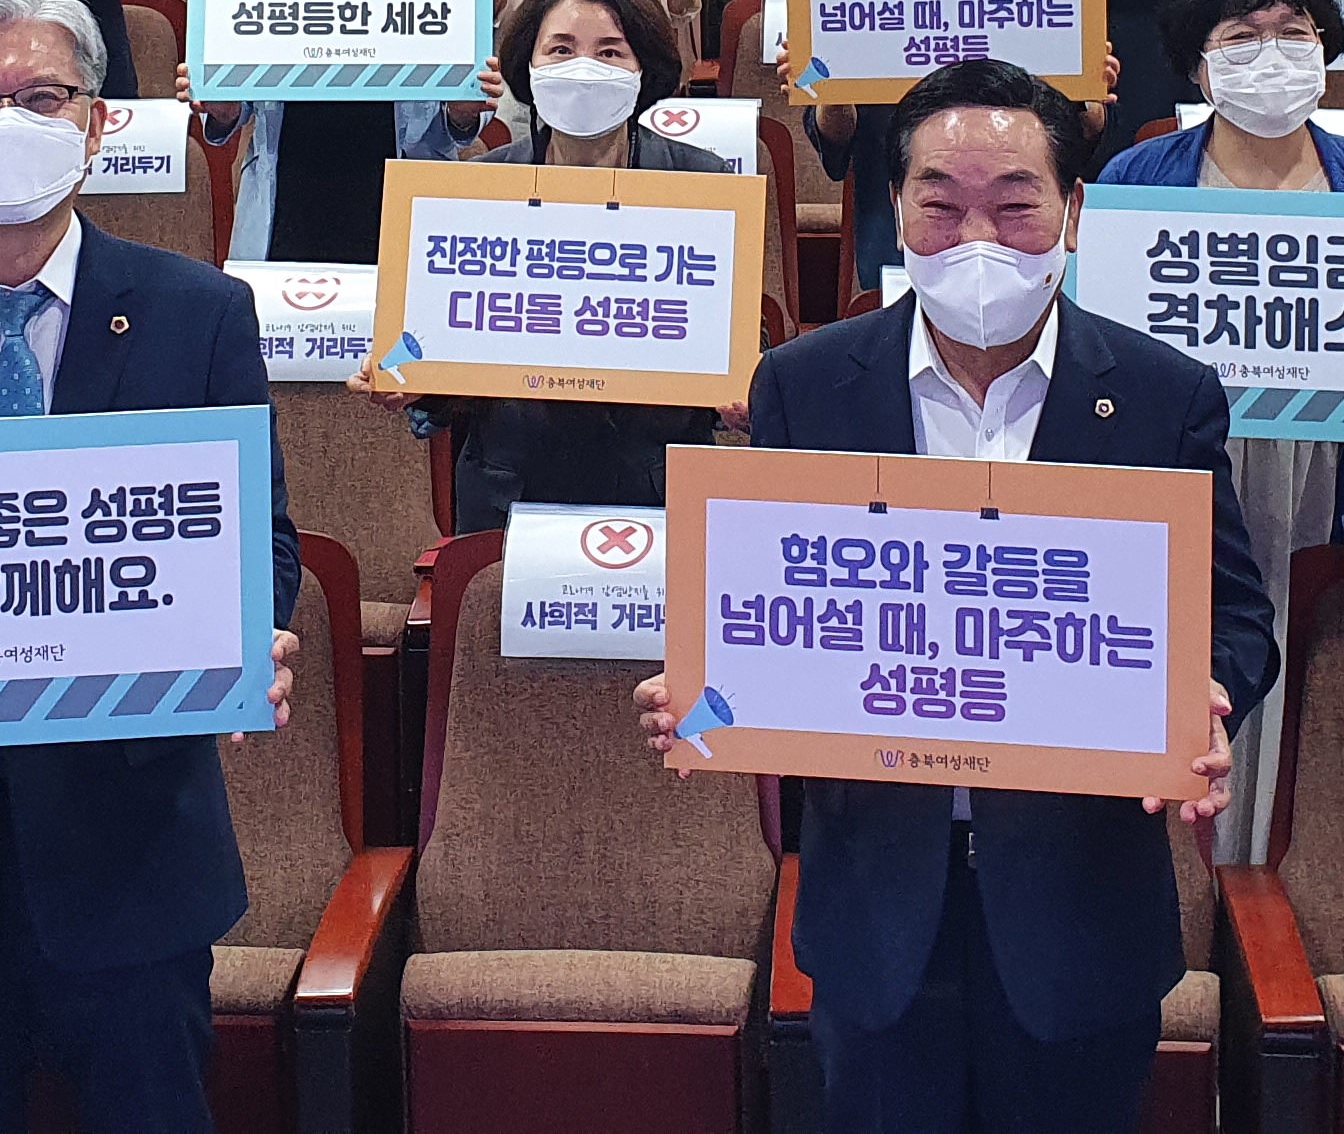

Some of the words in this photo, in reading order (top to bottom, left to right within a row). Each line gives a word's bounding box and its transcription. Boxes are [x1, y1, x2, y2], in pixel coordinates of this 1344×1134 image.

[231, 1, 373, 37] 성평등한
[381, 1, 452, 36] 세상
[819, 0, 905, 33] 넘어설
[912, 0, 950, 32] 때,
[102, 155, 171, 175] 거리두기
[426, 235, 521, 278] 진정한
[525, 239, 647, 283] 평등으로
[654, 244, 717, 287] 가는
[448, 289, 563, 335] 디딤돌
[574, 295, 689, 340] 성평등
[260, 337, 294, 359] 회적
[305, 337, 373, 359] 거리두
[1238, 364, 1311, 381] 충북여성재단
[81, 481, 223, 544] 성평등
[780, 532, 929, 594] 혐오와
[942, 542, 1090, 605] 갈등을
[521, 601, 598, 630] 사회적
[719, 594, 866, 654] 넘어설
[878, 601, 941, 661] 때,
[954, 605, 1155, 670] 마주하는
[859, 664, 1008, 723] 성평등
[907, 752, 992, 774] 충북여성재단
